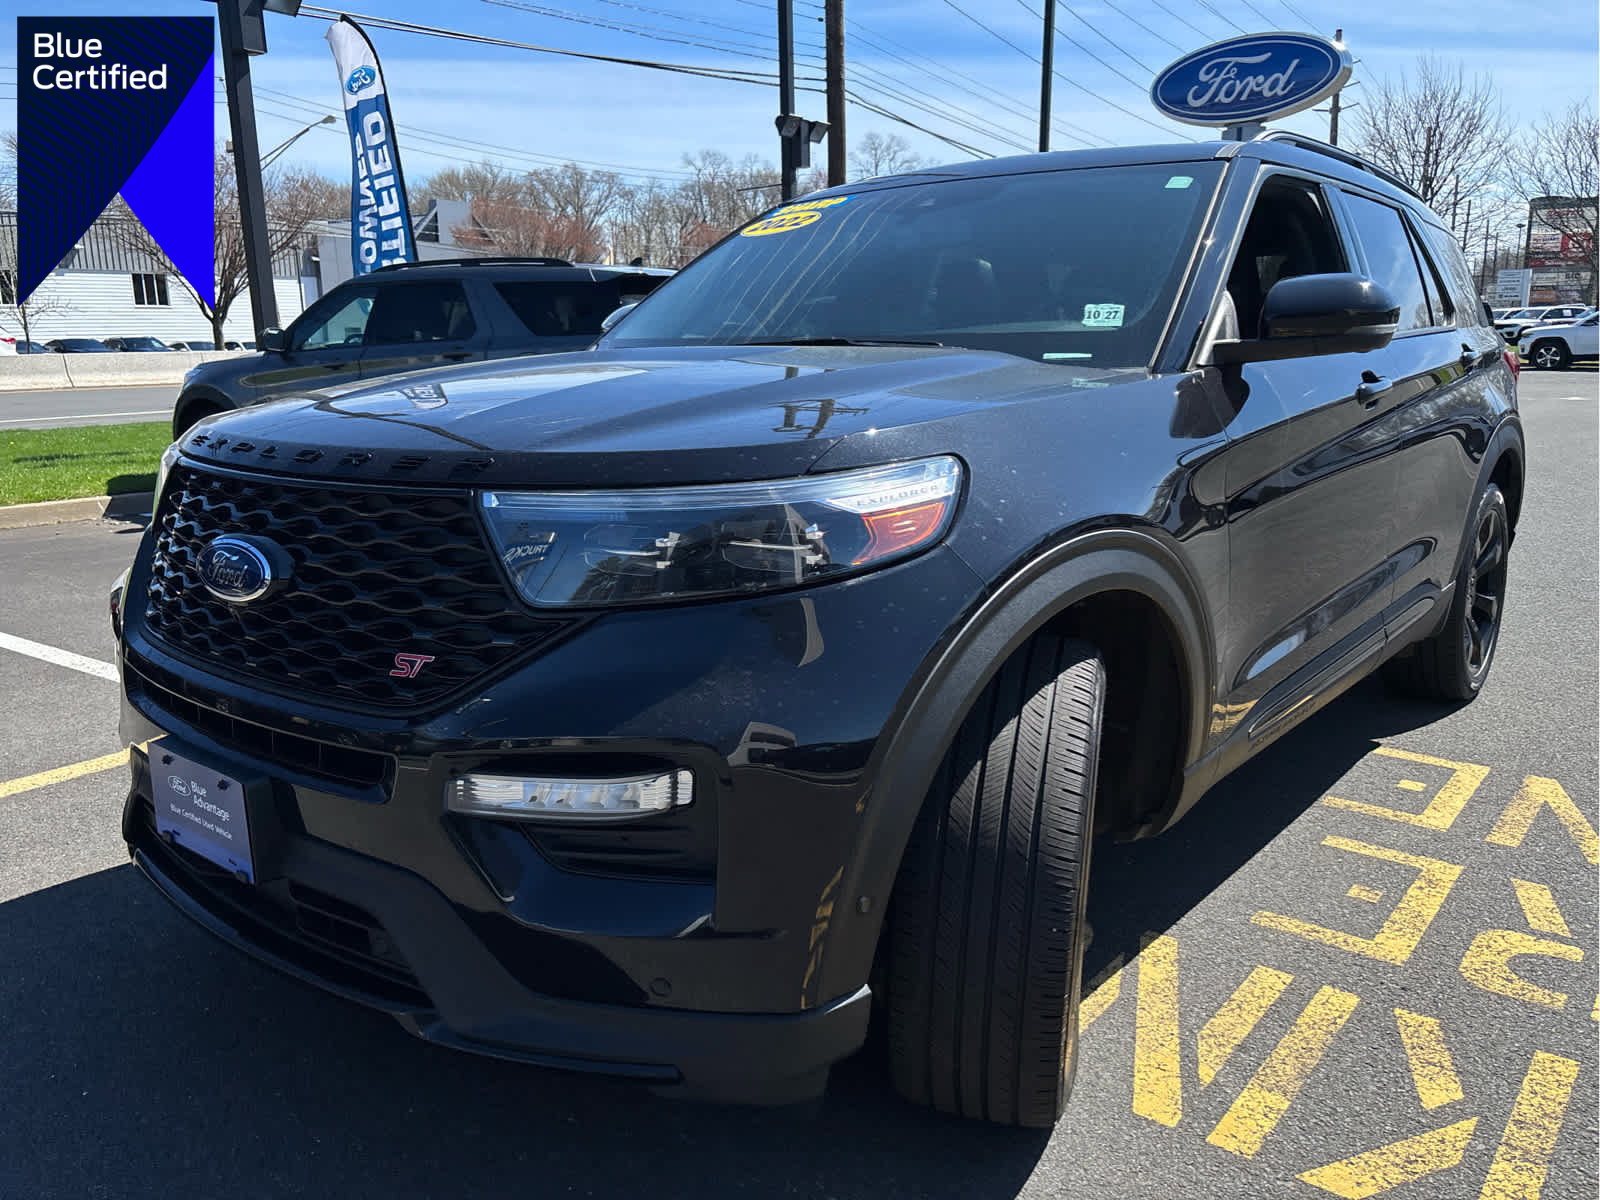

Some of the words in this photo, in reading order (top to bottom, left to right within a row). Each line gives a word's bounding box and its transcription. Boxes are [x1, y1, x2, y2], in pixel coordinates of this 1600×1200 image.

[1187, 51, 1301, 108] Ford
[1086, 310, 1101, 320] 10
[1104, 310, 1120, 320] 27
[191, 433, 498, 473] EXPLORER
[857, 484, 939, 506] EXPLORER
[207, 550, 250, 588] Ford
[389, 652, 435, 678] ST
[171, 777, 187, 794] Ford
[190, 780, 207, 797] Blue
[193, 794, 231, 821] Advantage
